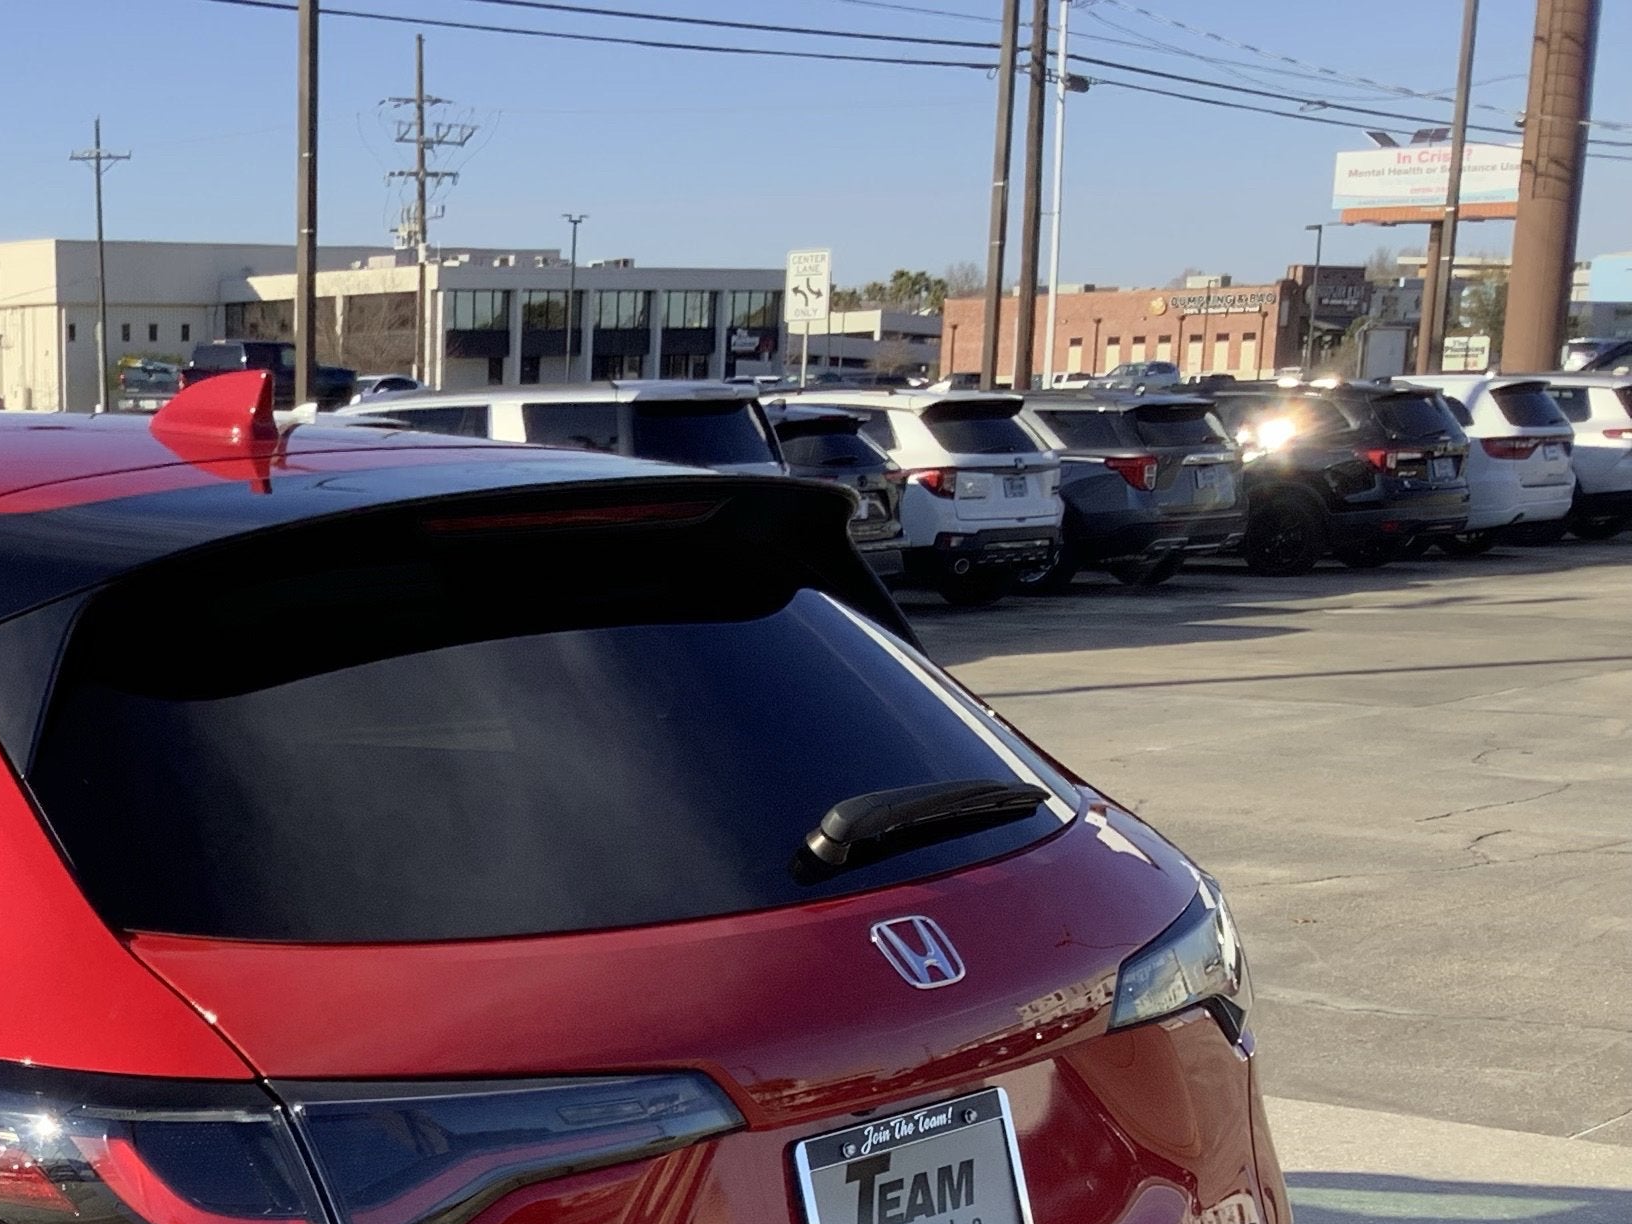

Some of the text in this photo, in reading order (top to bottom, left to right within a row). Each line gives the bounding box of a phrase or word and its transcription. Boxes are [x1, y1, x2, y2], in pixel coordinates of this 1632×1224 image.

[1396, 148, 1473, 164] In Cris?
[1348, 167, 1385, 177] Mental
[1388, 166, 1423, 176] Health
[1426, 166, 1438, 174] or
[792, 254, 827, 265] CENTER
[796, 264, 821, 274] LANE
[794, 308, 818, 318] ONLY
[861, 1106, 953, 1154] Join The Team!
